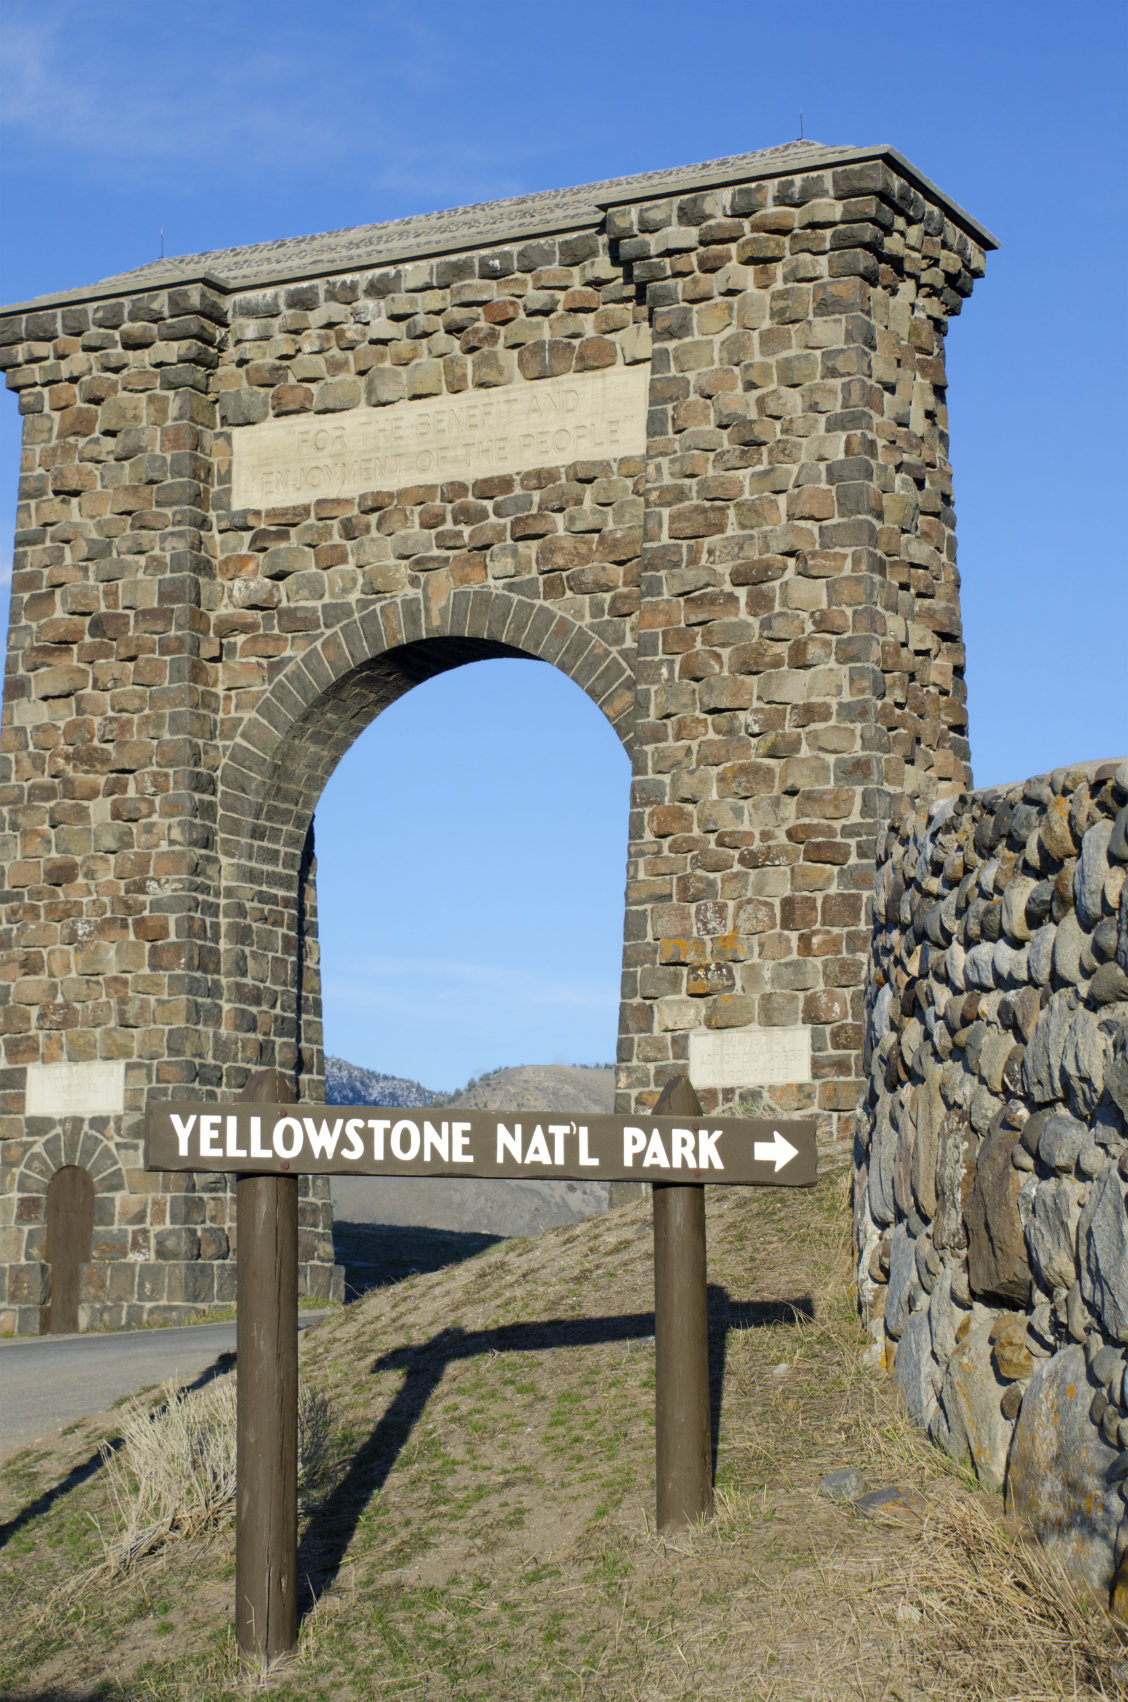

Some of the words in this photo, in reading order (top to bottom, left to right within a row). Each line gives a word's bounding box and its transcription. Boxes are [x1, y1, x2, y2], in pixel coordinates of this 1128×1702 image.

[359, 416, 405, 447] THE
[416, 398, 518, 437] BENEFIT
[526, 389, 580, 421] AND
[261, 453, 405, 496] ENJOYMENT
[416, 446, 449, 474] OF
[461, 437, 508, 468] THE
[170, 1114, 474, 1162] YELLOWSTONE
[623, 1126, 724, 1170] PARK
